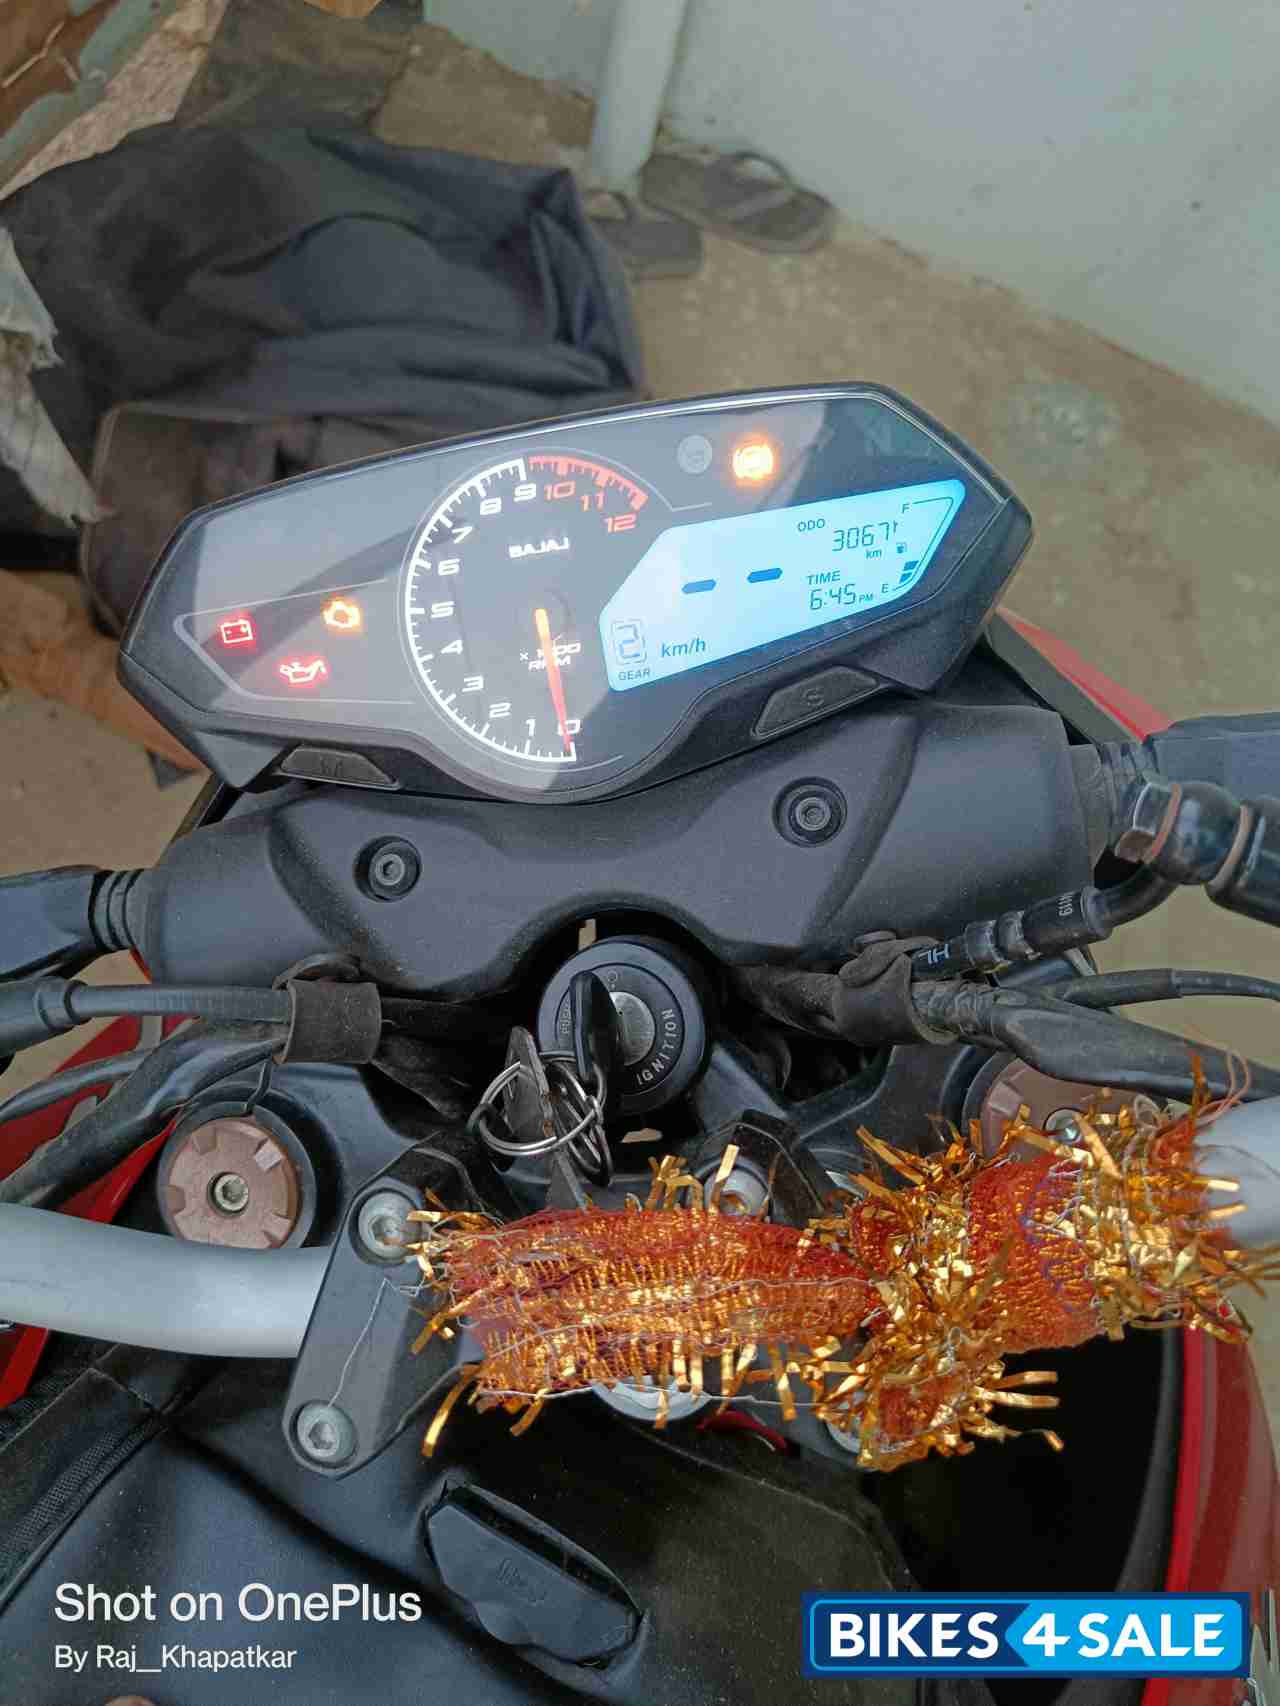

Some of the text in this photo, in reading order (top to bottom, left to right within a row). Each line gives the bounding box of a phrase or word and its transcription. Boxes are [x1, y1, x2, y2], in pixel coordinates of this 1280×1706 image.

[513, 483, 537, 501] 9
[544, 481, 576, 500] 10
[480, 497, 501, 515] 8
[580, 491, 604, 511] 11
[901, 503, 911, 514] F
[606, 514, 636, 532] 12
[797, 518, 826, 532] ODO
[451, 526, 473, 543] 7
[509, 537, 569, 558] BAJAJ
[865, 547, 882, 560] km
[438, 559, 460, 575] 6
[807, 570, 841, 585] TIME
[810, 583, 874, 610] 6:45 PM
[881, 583, 890, 593] E
[431, 601, 455, 618] 5
[440, 639, 464, 654] 4
[536, 642, 581, 658] 100
[661, 636, 706, 658] km/h
[617, 667, 650, 681] GEAR
[462, 675, 484, 692] 3
[489, 702, 512, 718] 2
[525, 719, 536, 736] 1
[636, 1008, 678, 1086] IGNITION
